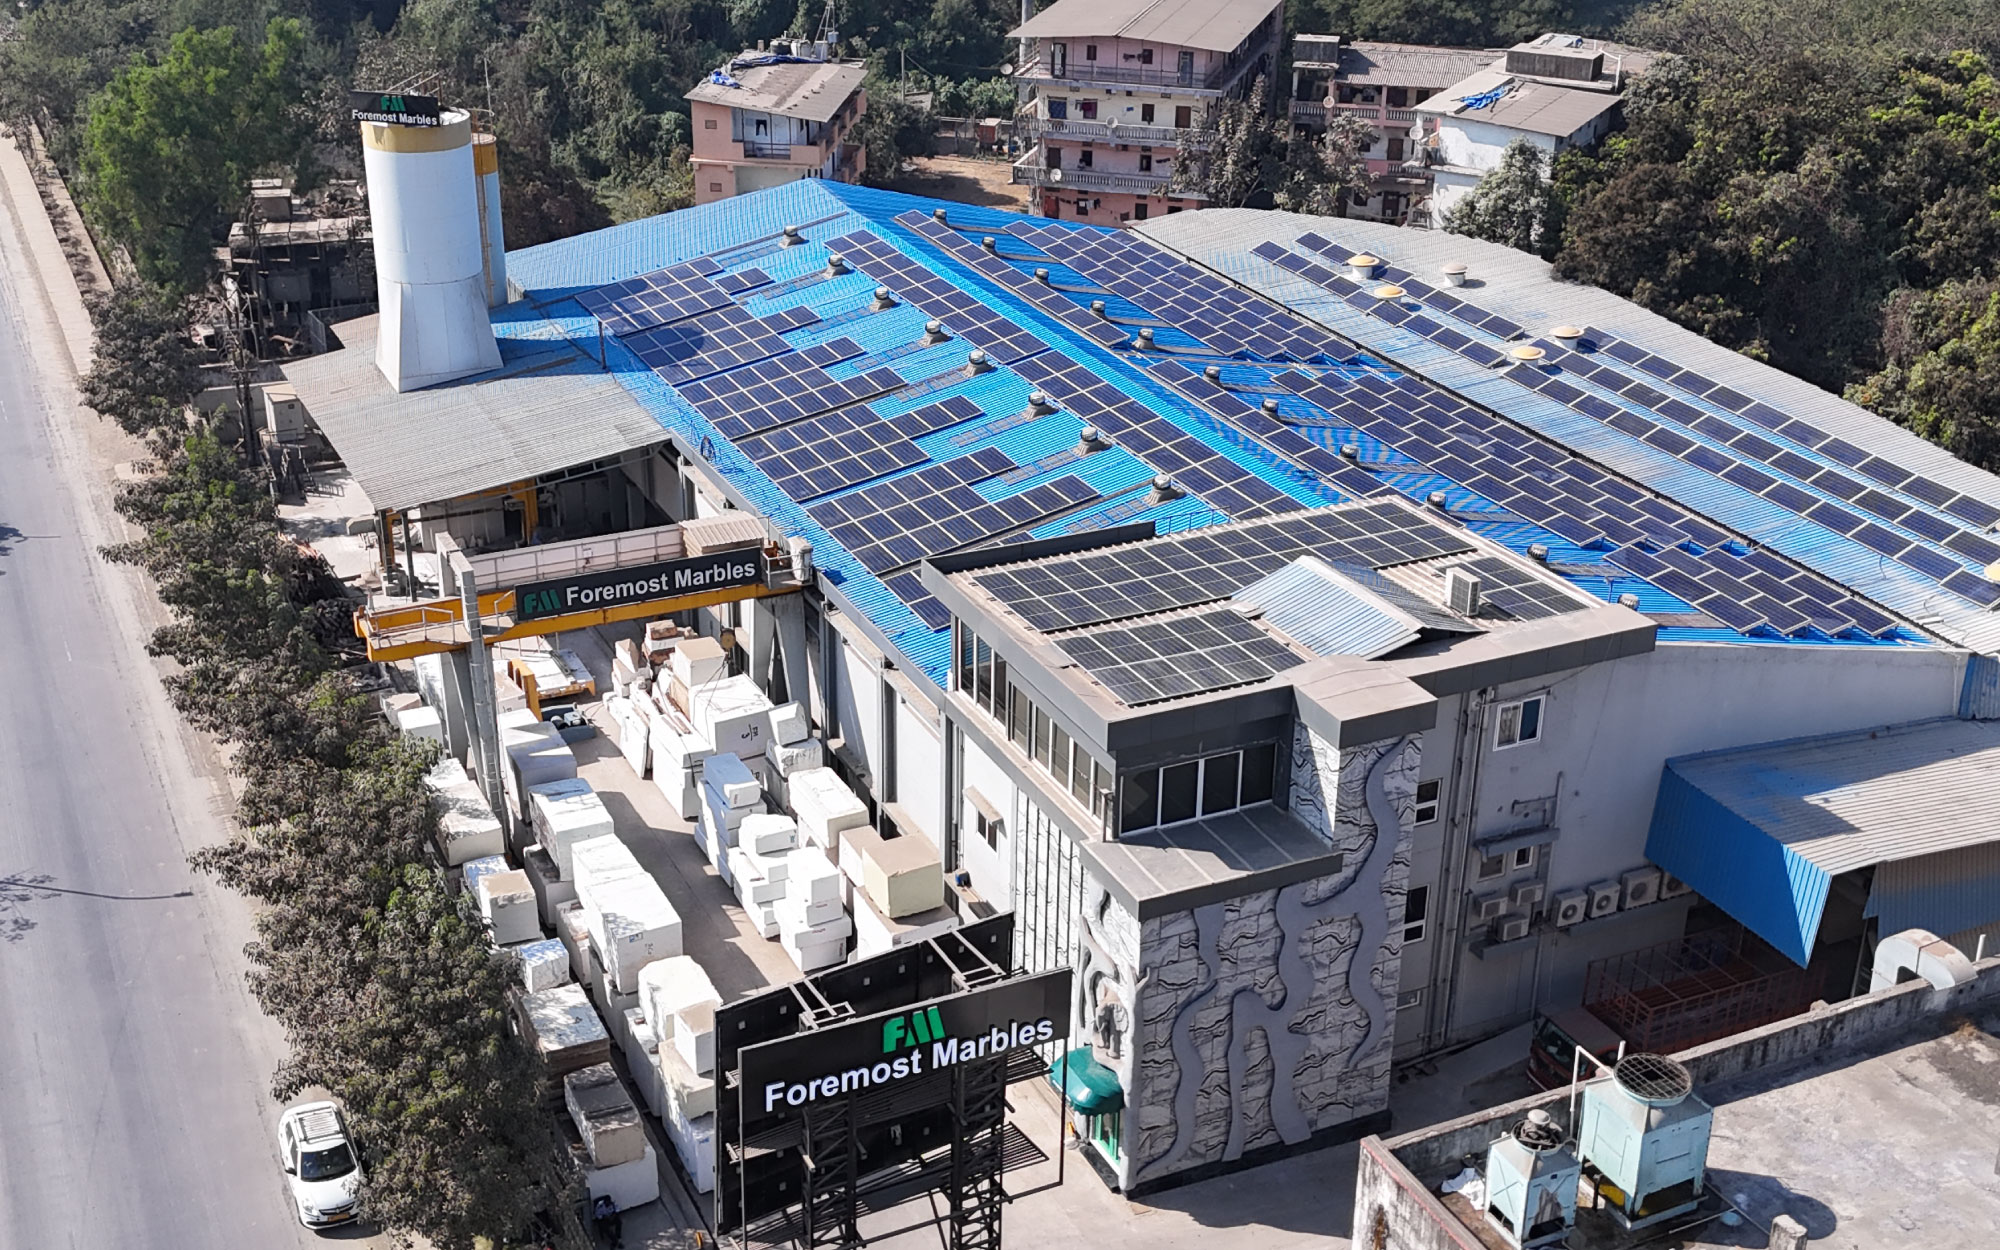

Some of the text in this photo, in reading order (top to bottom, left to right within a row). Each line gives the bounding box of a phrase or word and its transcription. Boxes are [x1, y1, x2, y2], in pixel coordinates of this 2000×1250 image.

[352, 109, 438, 125] Foremost Marbles
[566, 573, 669, 606] Foremost
[674, 561, 756, 589] Marbles
[765, 1017, 1054, 1112] Foremost Marbles
